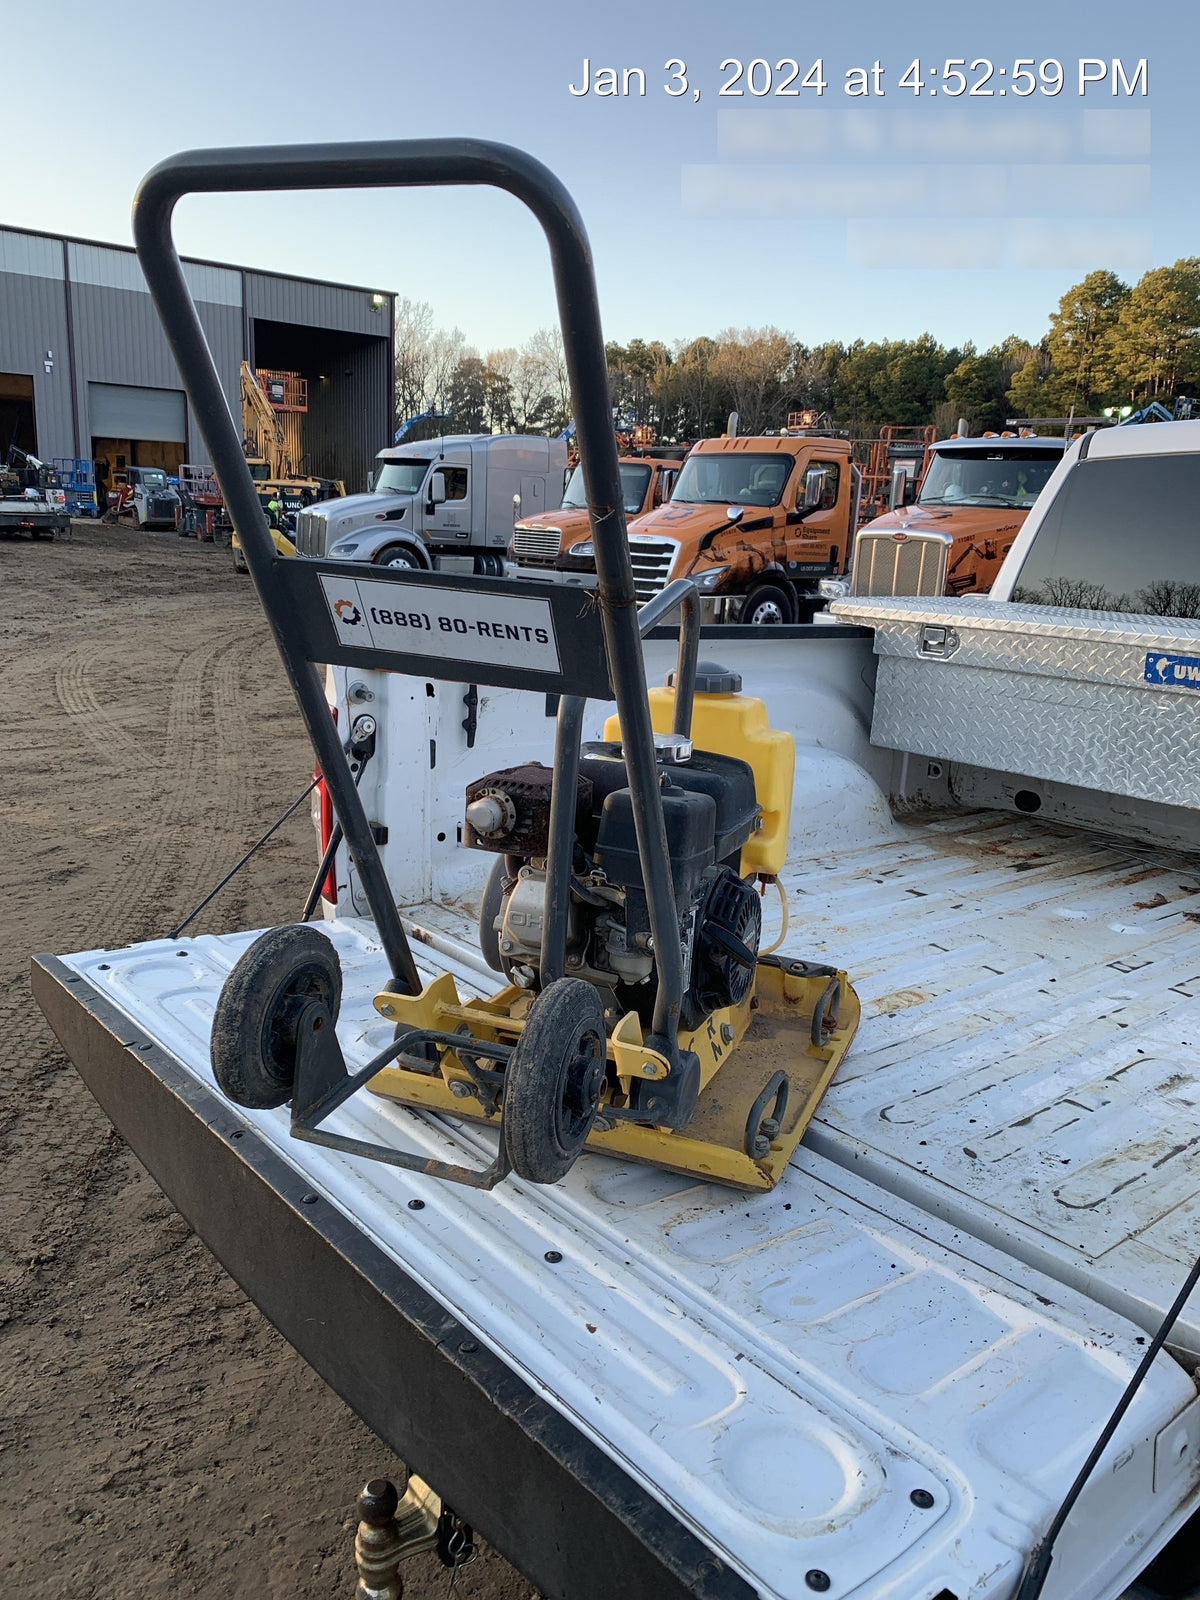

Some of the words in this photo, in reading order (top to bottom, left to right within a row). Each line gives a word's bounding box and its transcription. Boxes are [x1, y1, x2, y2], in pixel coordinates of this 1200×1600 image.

[370, 607, 431, 631] (888)
[438, 617, 549, 644] 80-RENTS
[508, 910, 545, 930] OH
